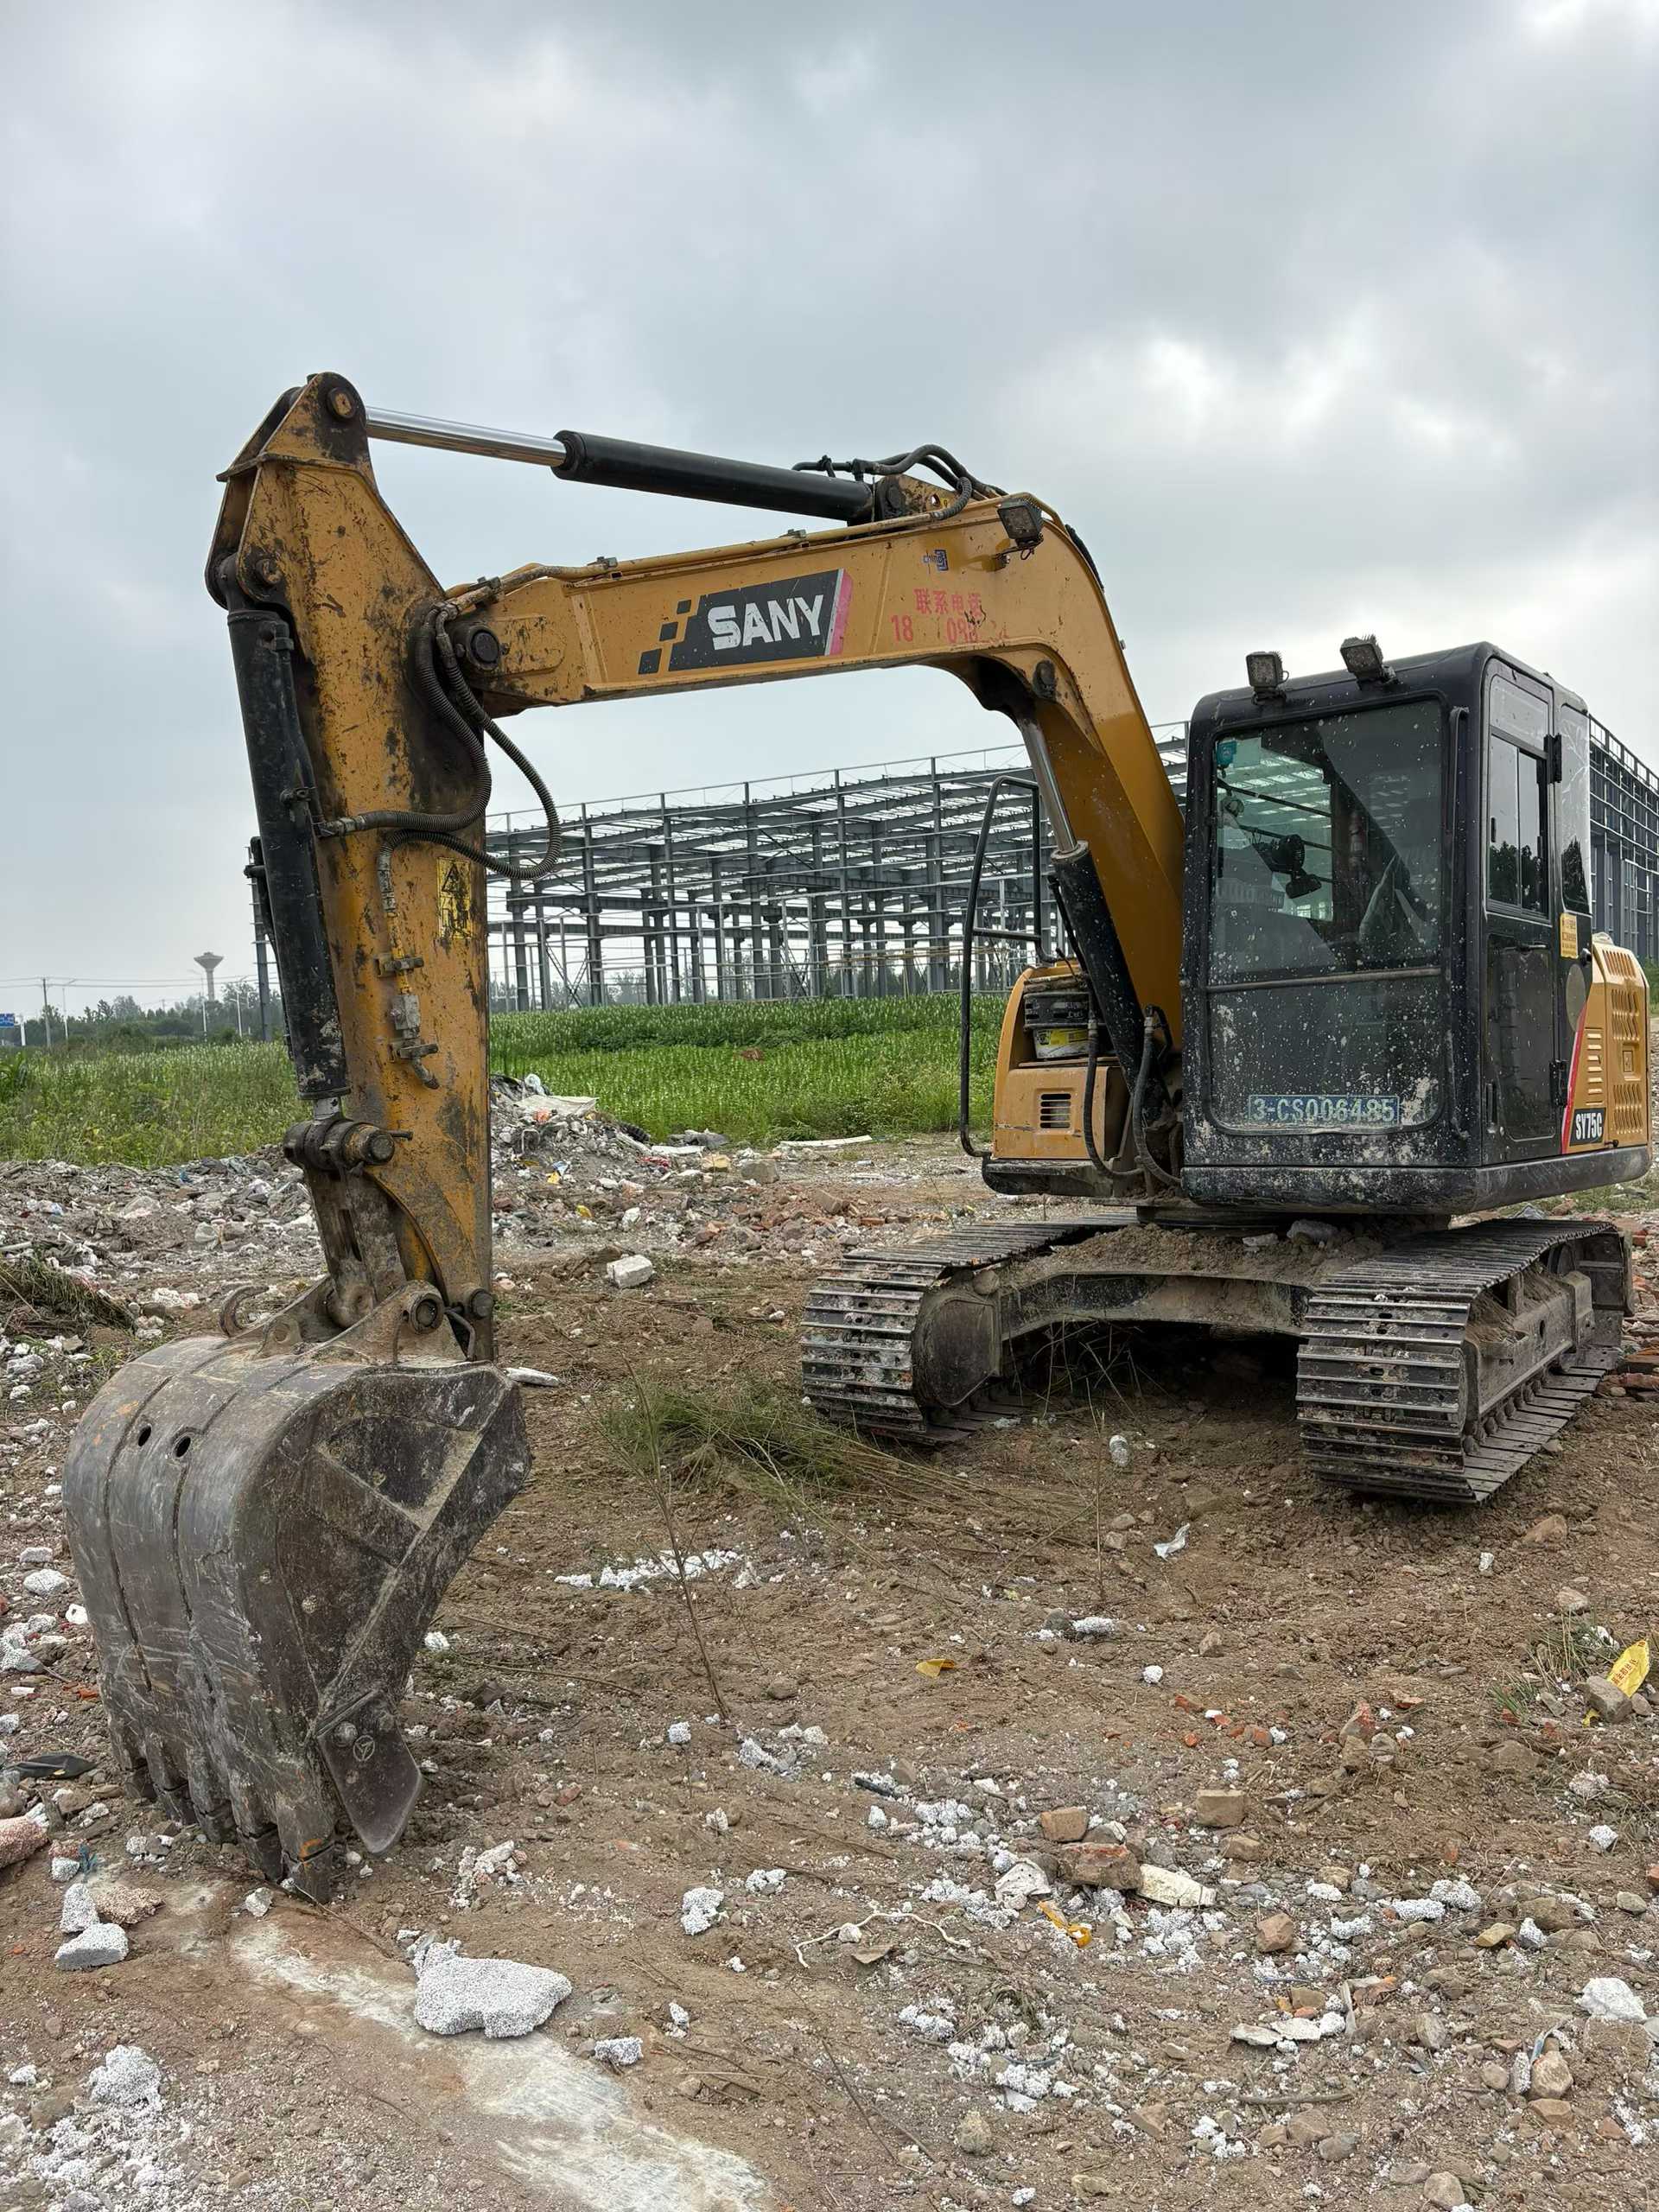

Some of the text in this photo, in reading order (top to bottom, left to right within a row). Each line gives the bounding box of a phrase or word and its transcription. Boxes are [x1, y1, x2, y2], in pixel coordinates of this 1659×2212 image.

[912, 588, 982, 617] 联系电话
[707, 594, 823, 651] SANY
[890, 613, 913, 643] 18
[1575, 1112, 1603, 1141] SY75C
